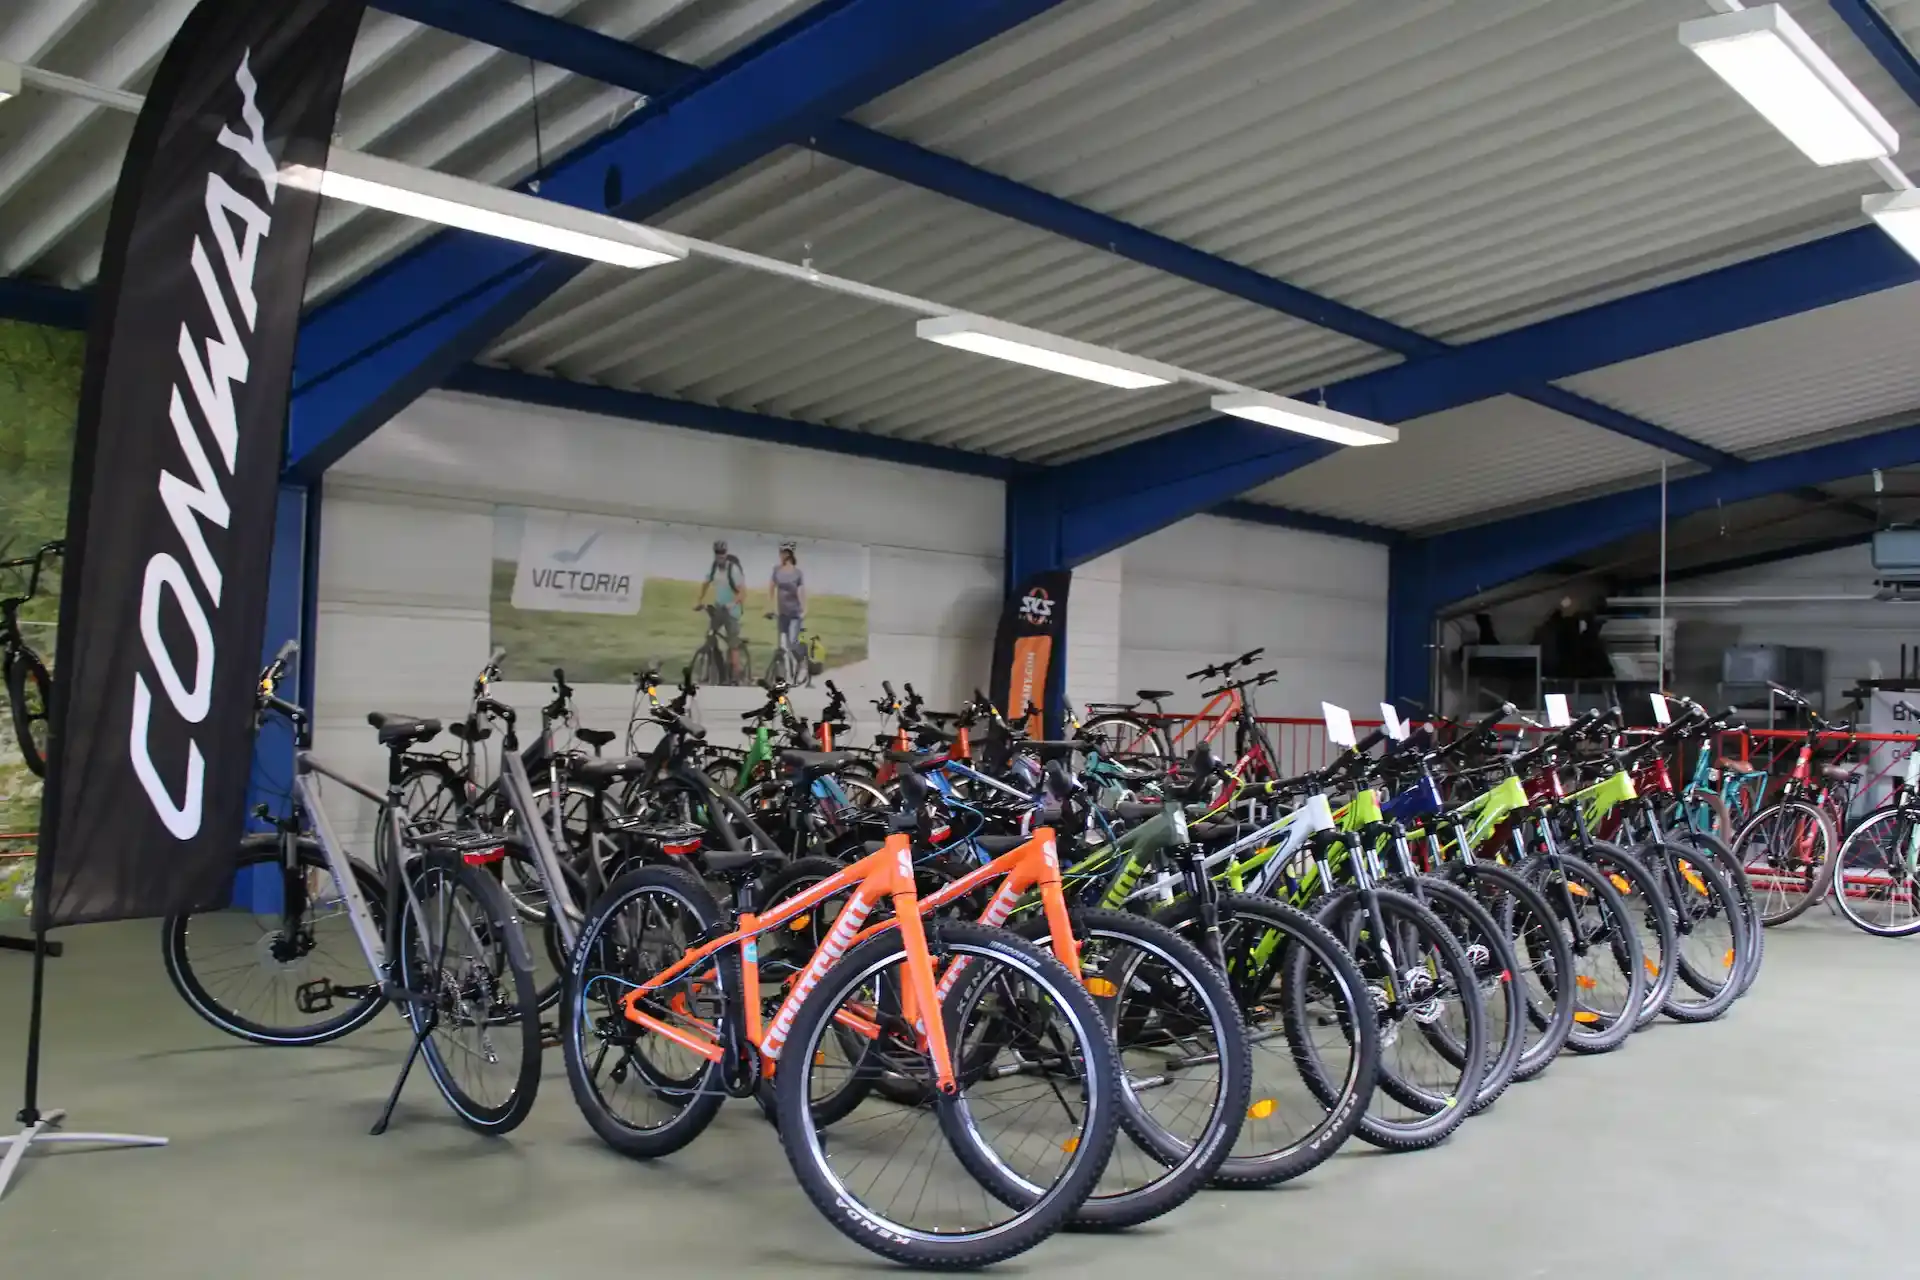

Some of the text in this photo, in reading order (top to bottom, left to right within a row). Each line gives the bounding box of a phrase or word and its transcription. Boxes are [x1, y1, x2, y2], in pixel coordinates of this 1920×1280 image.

[131, 46, 277, 841] CONWAY
[532, 568, 630, 595] VICTORIA
[836, 1196, 911, 1245] KENDA
